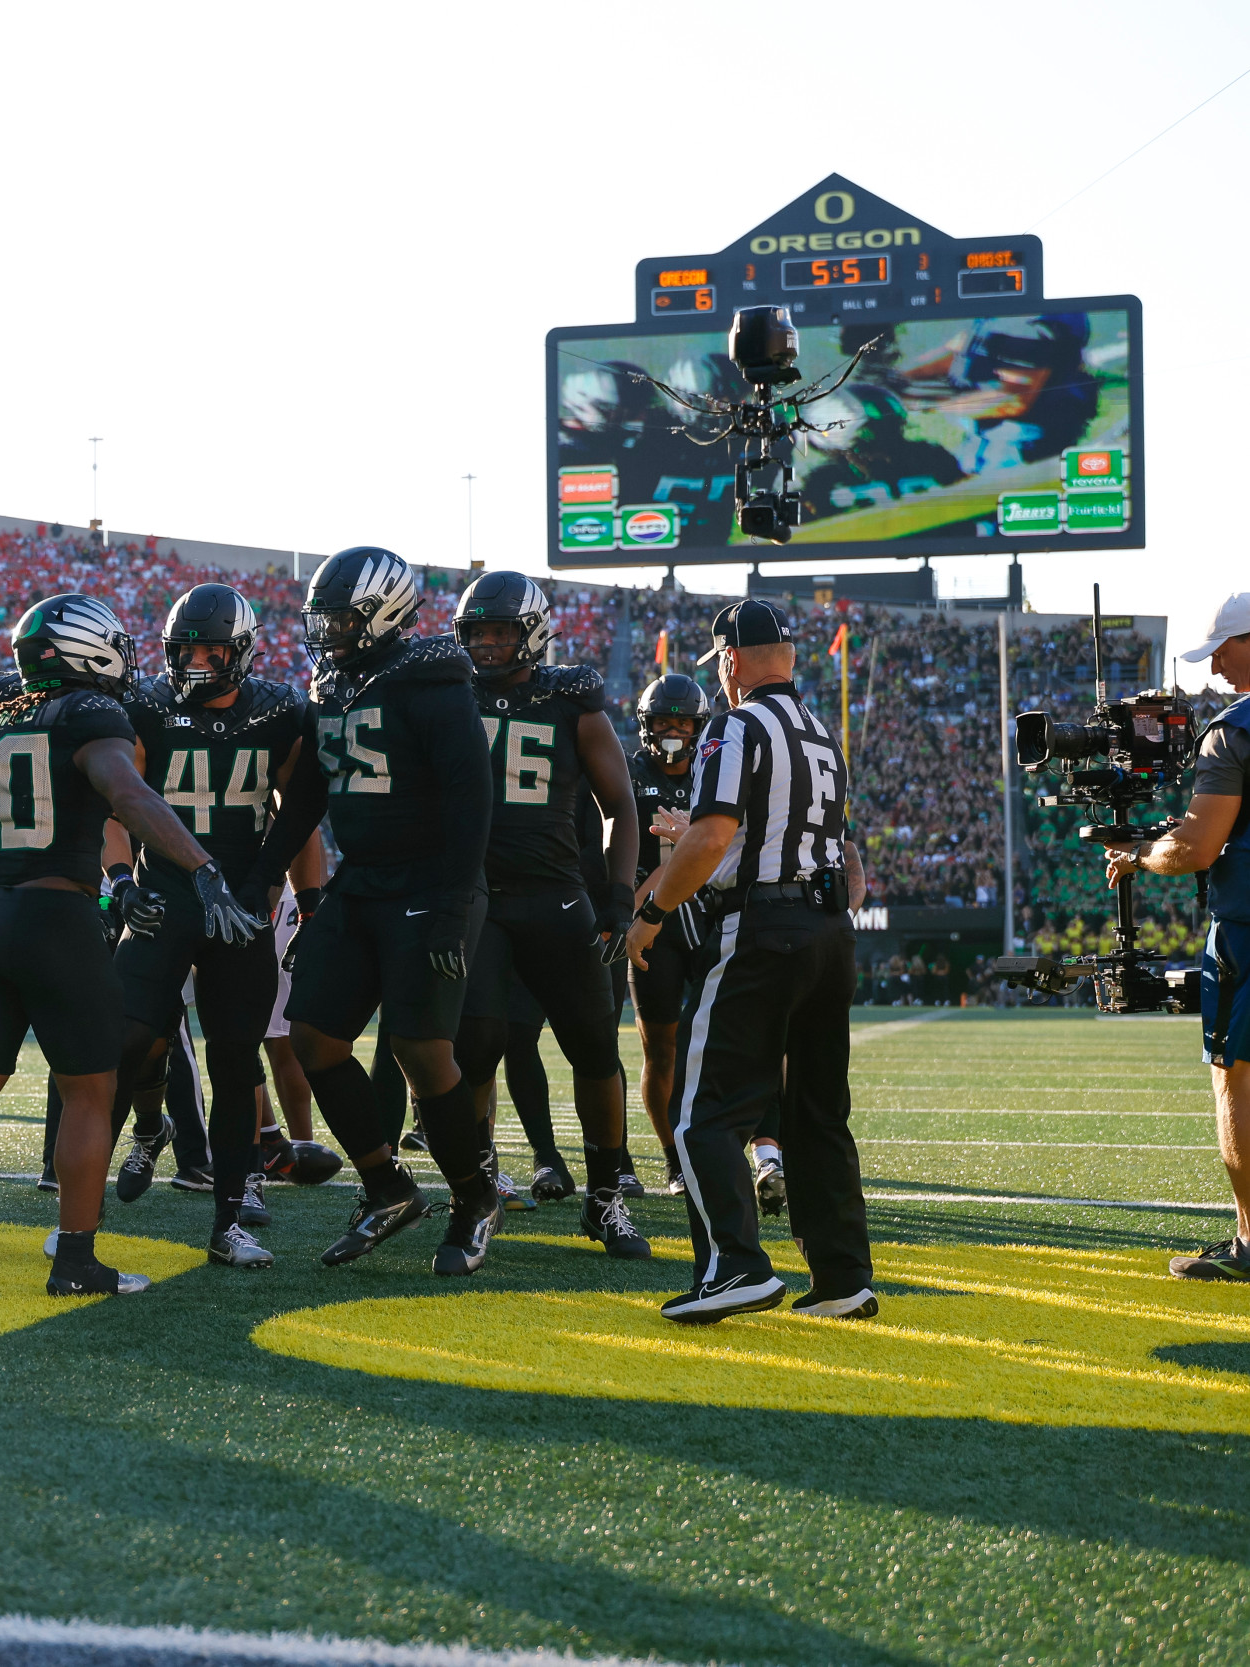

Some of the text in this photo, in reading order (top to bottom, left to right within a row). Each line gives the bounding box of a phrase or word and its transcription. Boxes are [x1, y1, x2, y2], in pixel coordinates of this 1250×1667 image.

[814, 190, 855, 224] O
[750, 227, 921, 255] OREGON
[918, 253, 929, 270] 3
[659, 268, 708, 288] OREGON
[745, 263, 756, 281] 3
[811, 257, 886, 286] 5:51
[915, 270, 930, 281] TOL
[1006, 270, 1023, 291] 7
[742, 280, 757, 290] TOL
[695, 287, 713, 311] 6
[842, 297, 878, 310] BALL ON
[934, 286, 942, 304] 1
[1071, 476, 1118, 487] TOYOTA
[1068, 503, 1122, 517] Fairfield
[781, 626, 791, 637] RR
[23, 679, 62, 693] CKS
[163, 748, 270, 836] 44
[800, 740, 838, 827] F
